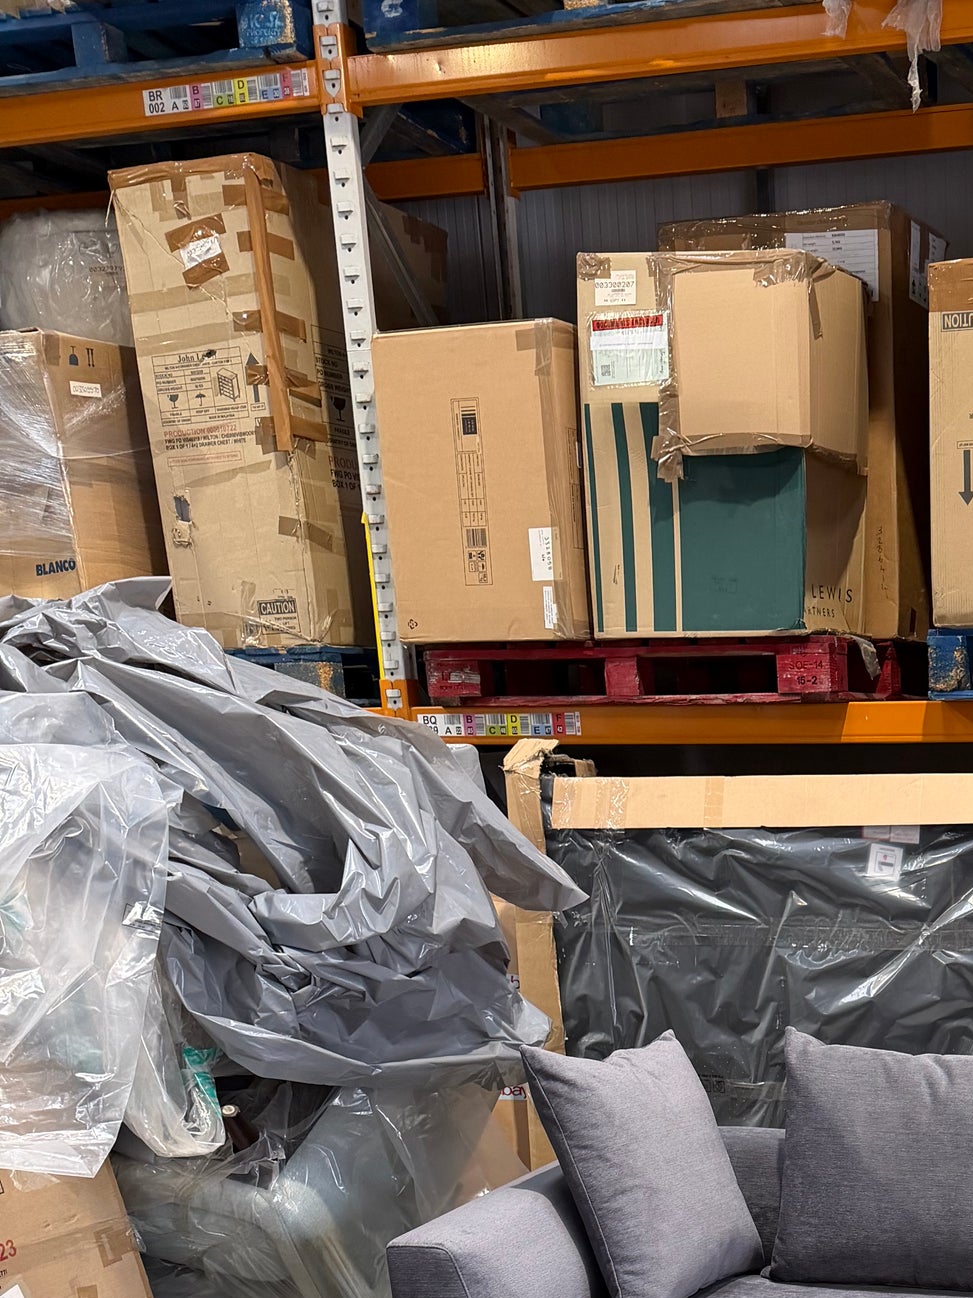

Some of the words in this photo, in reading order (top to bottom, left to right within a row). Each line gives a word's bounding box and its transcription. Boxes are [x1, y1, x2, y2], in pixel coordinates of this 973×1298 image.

[238, 80, 244, 89] D
[192, 86, 199, 94] B
[262, 90, 267, 99] E
[149, 90, 163, 101] BR
[217, 95, 223, 105] C
[149, 103, 165, 113] 002
[172, 102, 178, 110] A
[164, 428, 205, 437] PRODUCTION
[36, 558, 76, 576] BLANCO
[812, 584, 852, 603] LEWIS
[260, 601, 294, 614] CAUTION
[804, 606, 835, 618] ARTNERS
[797, 676, 818, 685] 15-2
[423, 716, 437, 725] BQ
[510, 715, 517, 723] D
[556, 714, 562, 722] F
[445, 727, 452, 735] A
[534, 726, 540, 734] E
